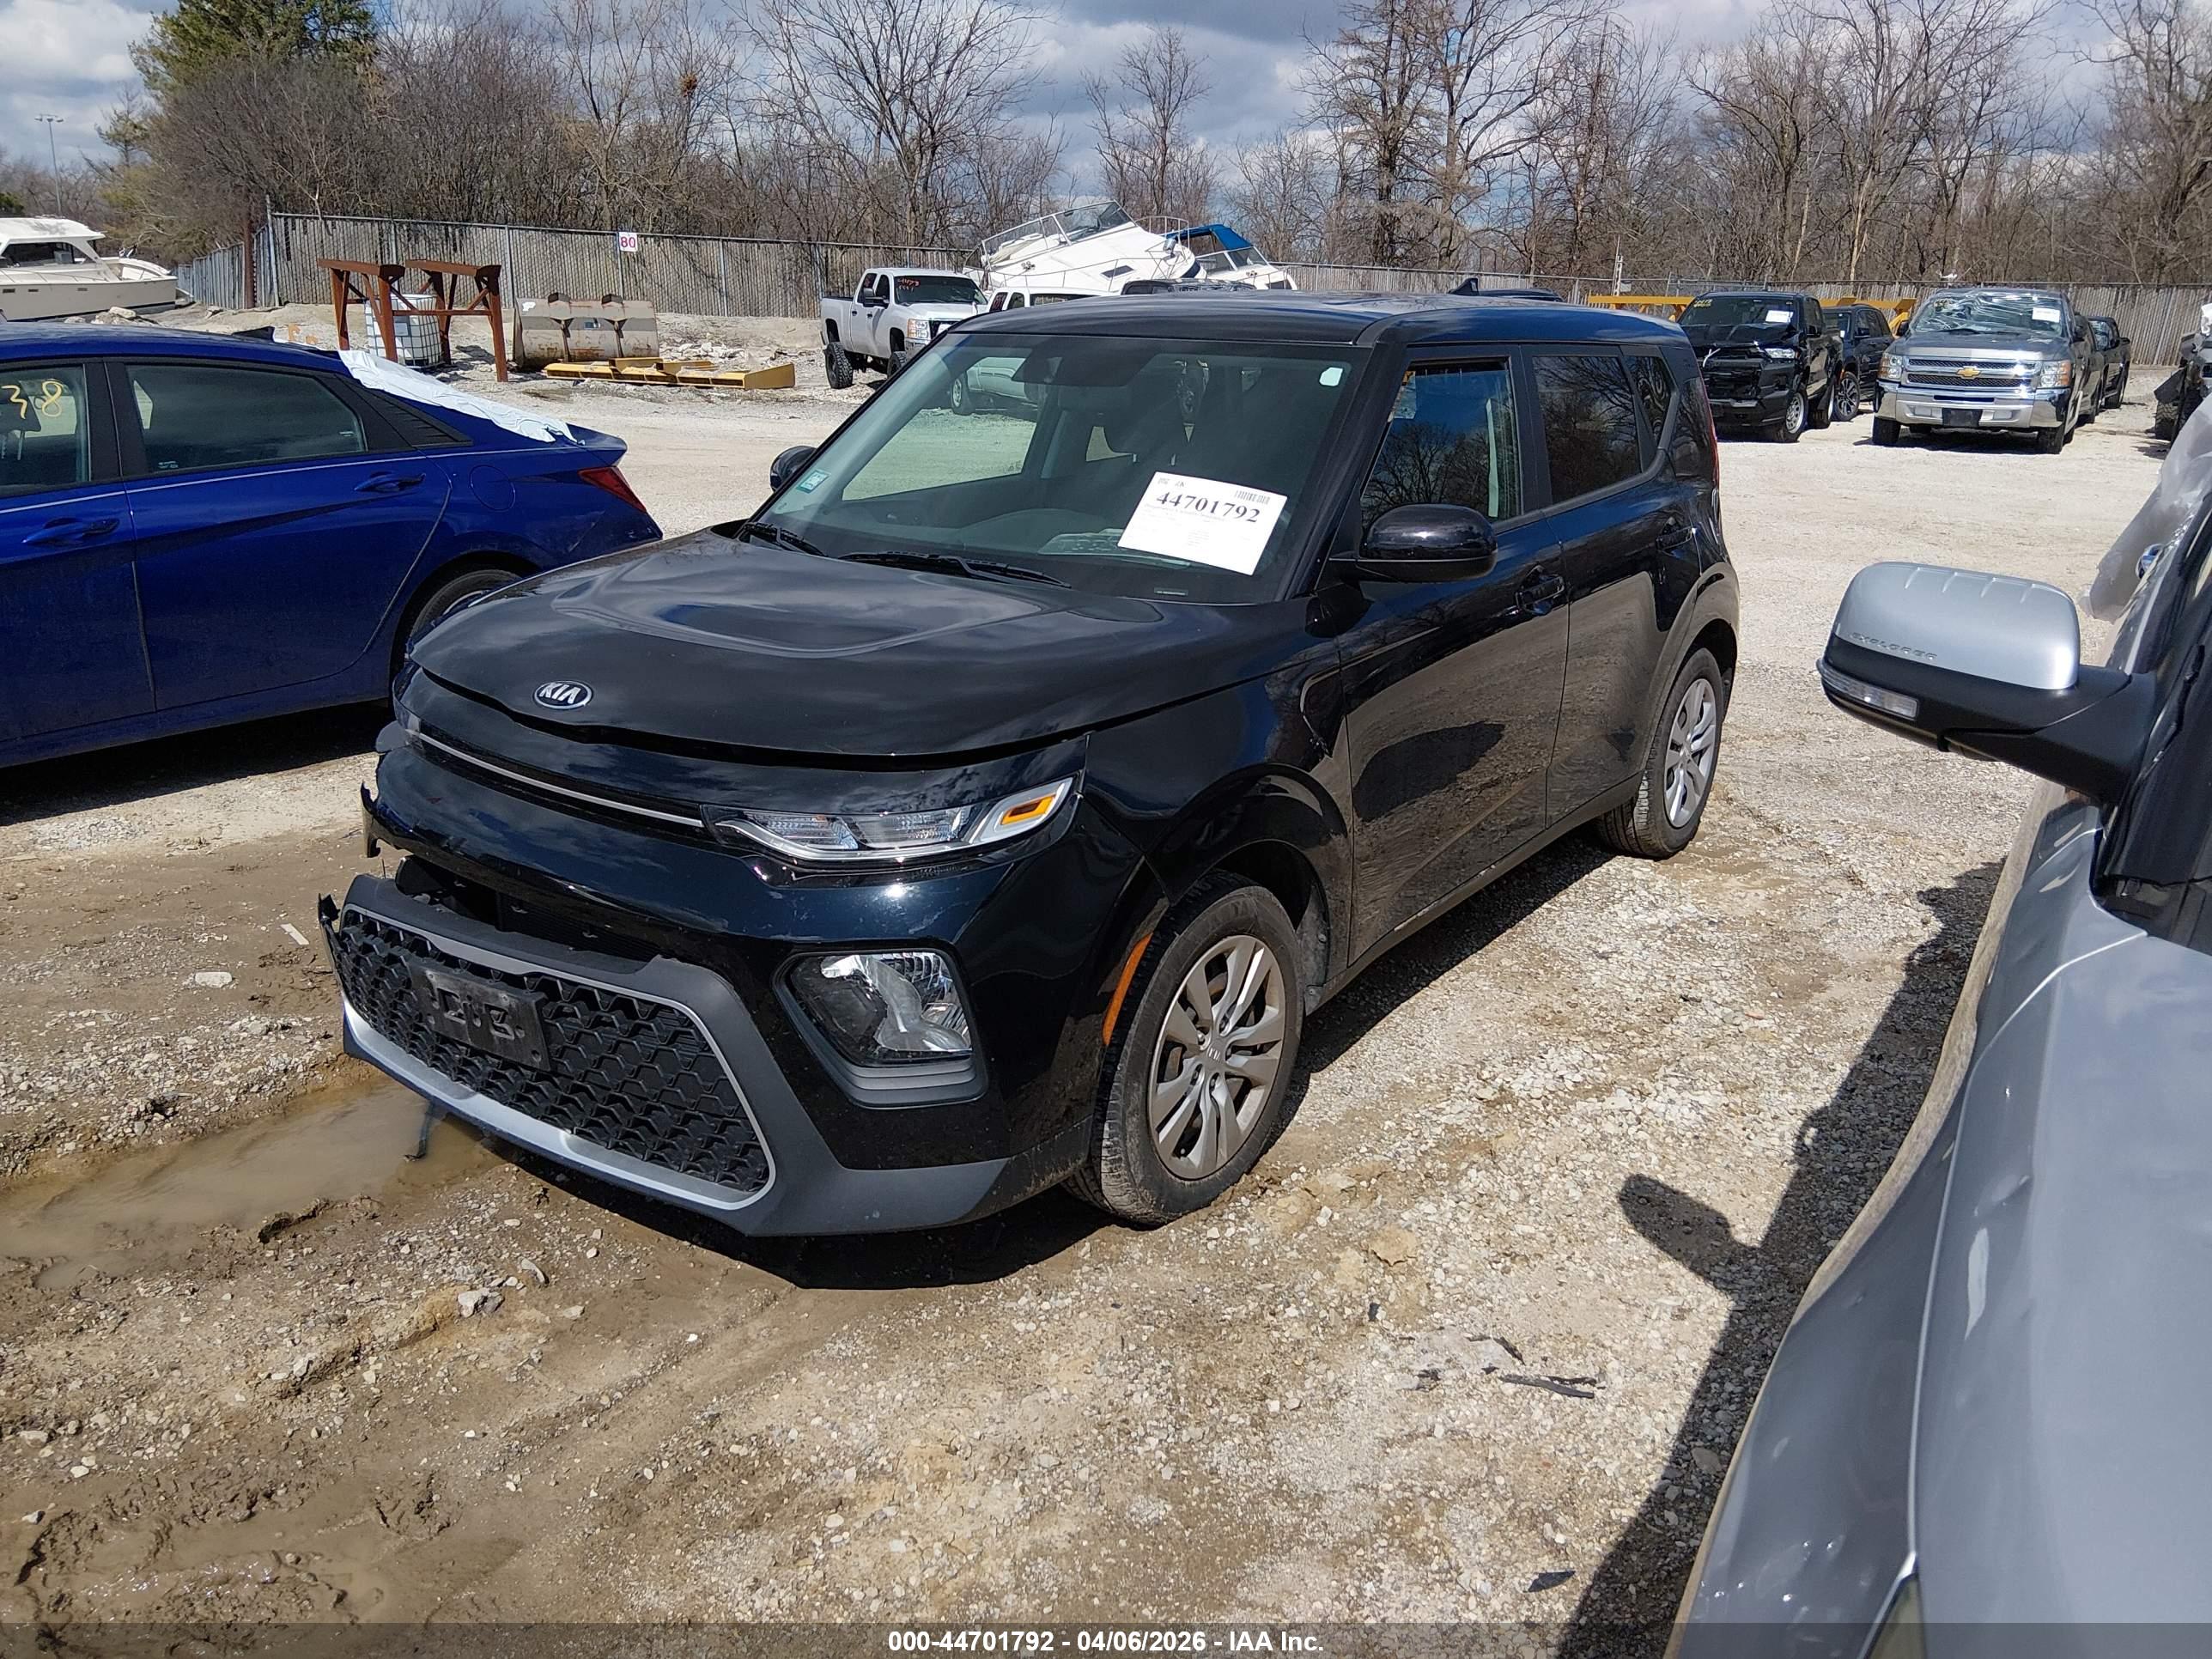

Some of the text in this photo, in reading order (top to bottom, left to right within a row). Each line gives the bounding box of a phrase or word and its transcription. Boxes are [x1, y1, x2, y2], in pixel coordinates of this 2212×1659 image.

[621, 236, 636, 248] 80
[1156, 491, 1261, 523] 44701792
[538, 683, 581, 704] KIA
